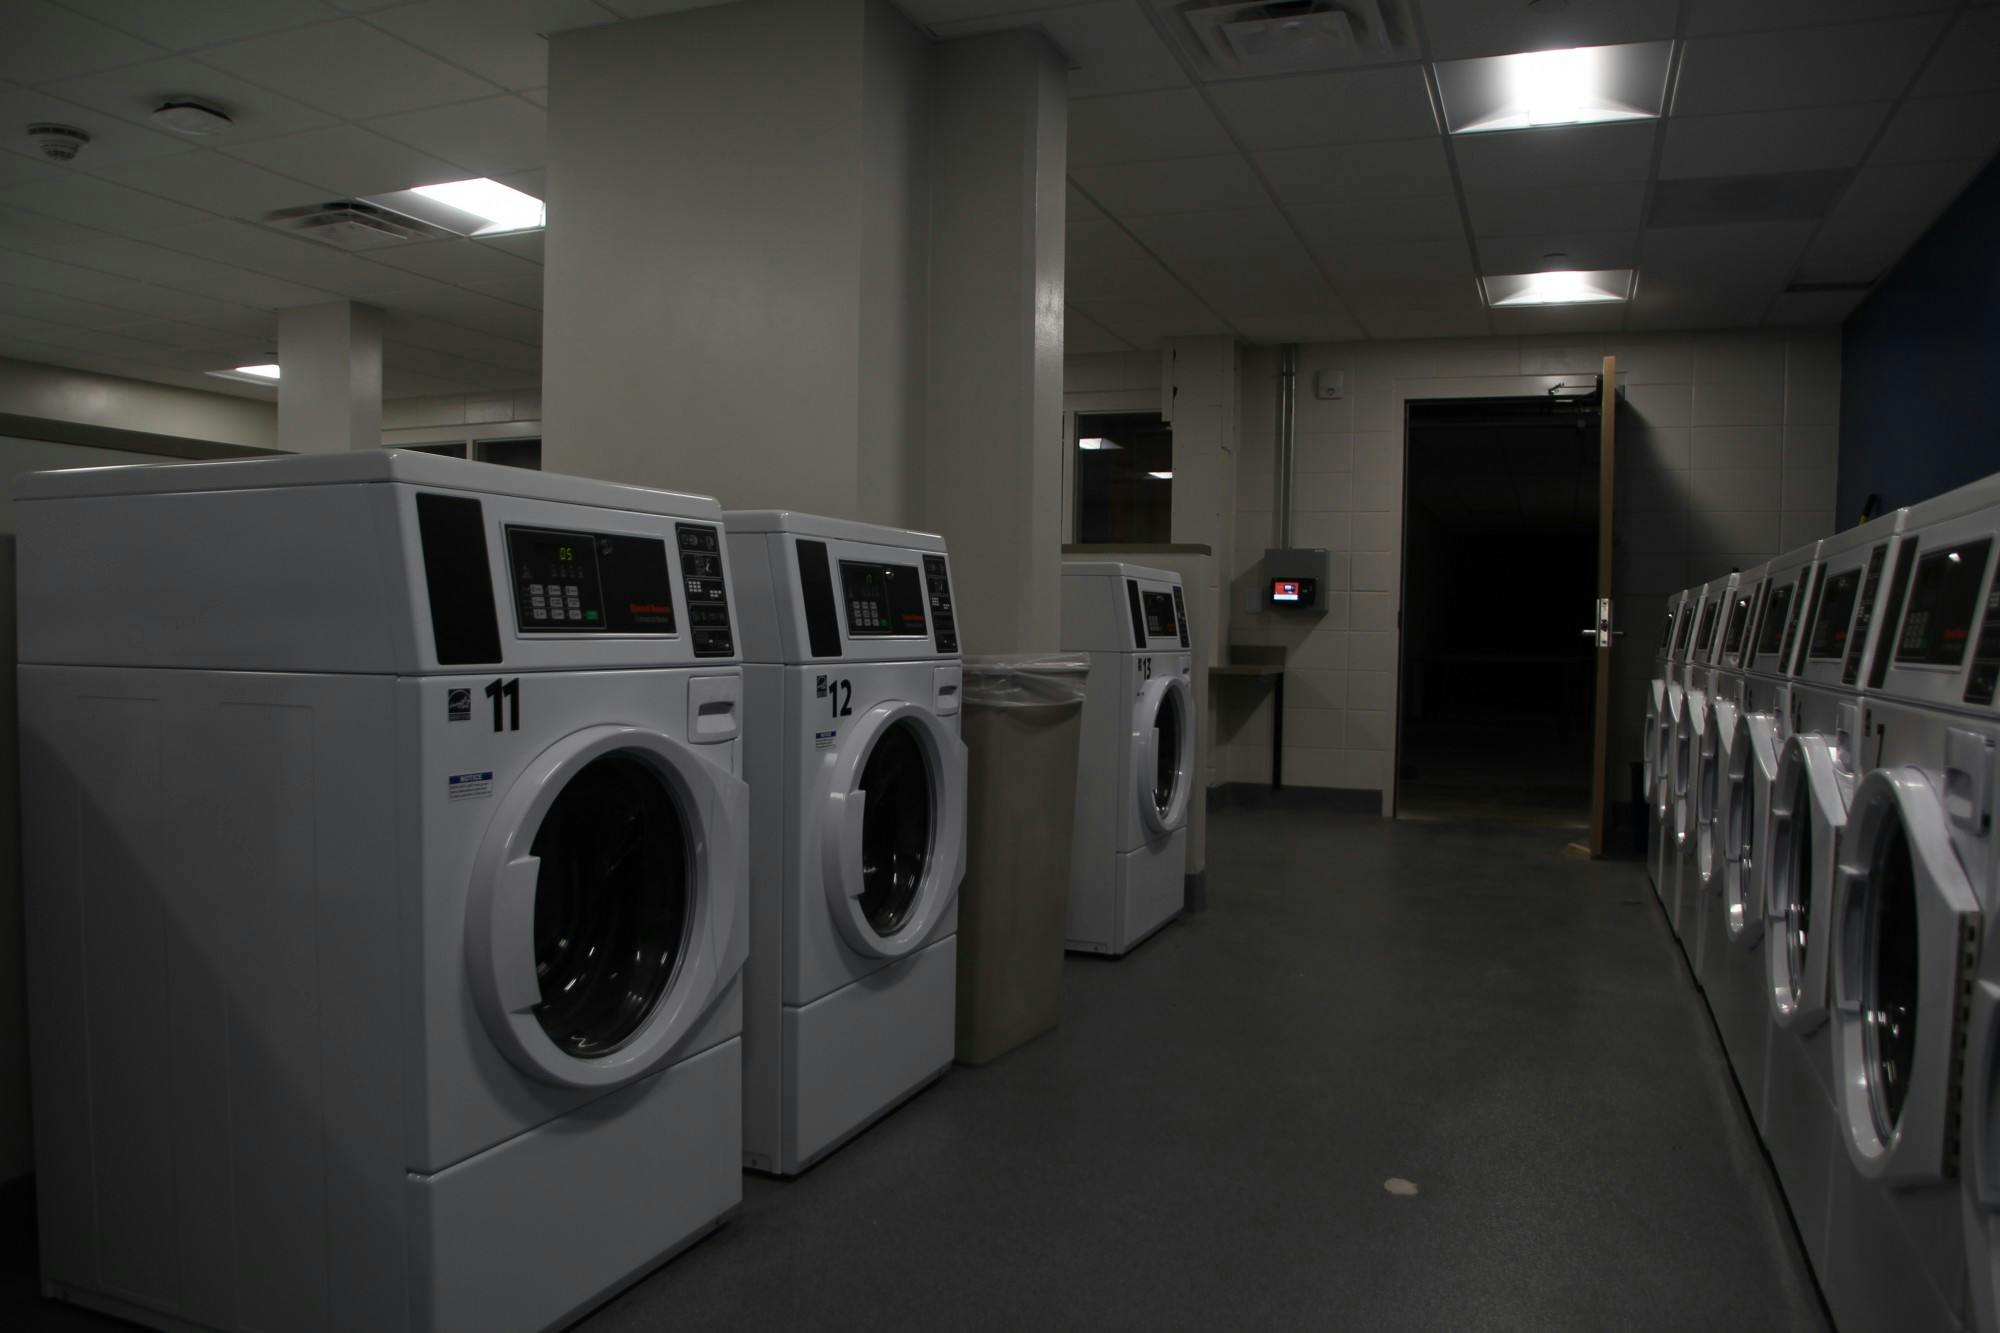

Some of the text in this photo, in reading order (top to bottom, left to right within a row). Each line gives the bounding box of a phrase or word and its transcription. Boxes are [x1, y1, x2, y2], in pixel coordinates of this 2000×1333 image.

[1143, 657, 1151, 680] 13
[485, 678, 519, 732] 11
[829, 679, 852, 718] 12
